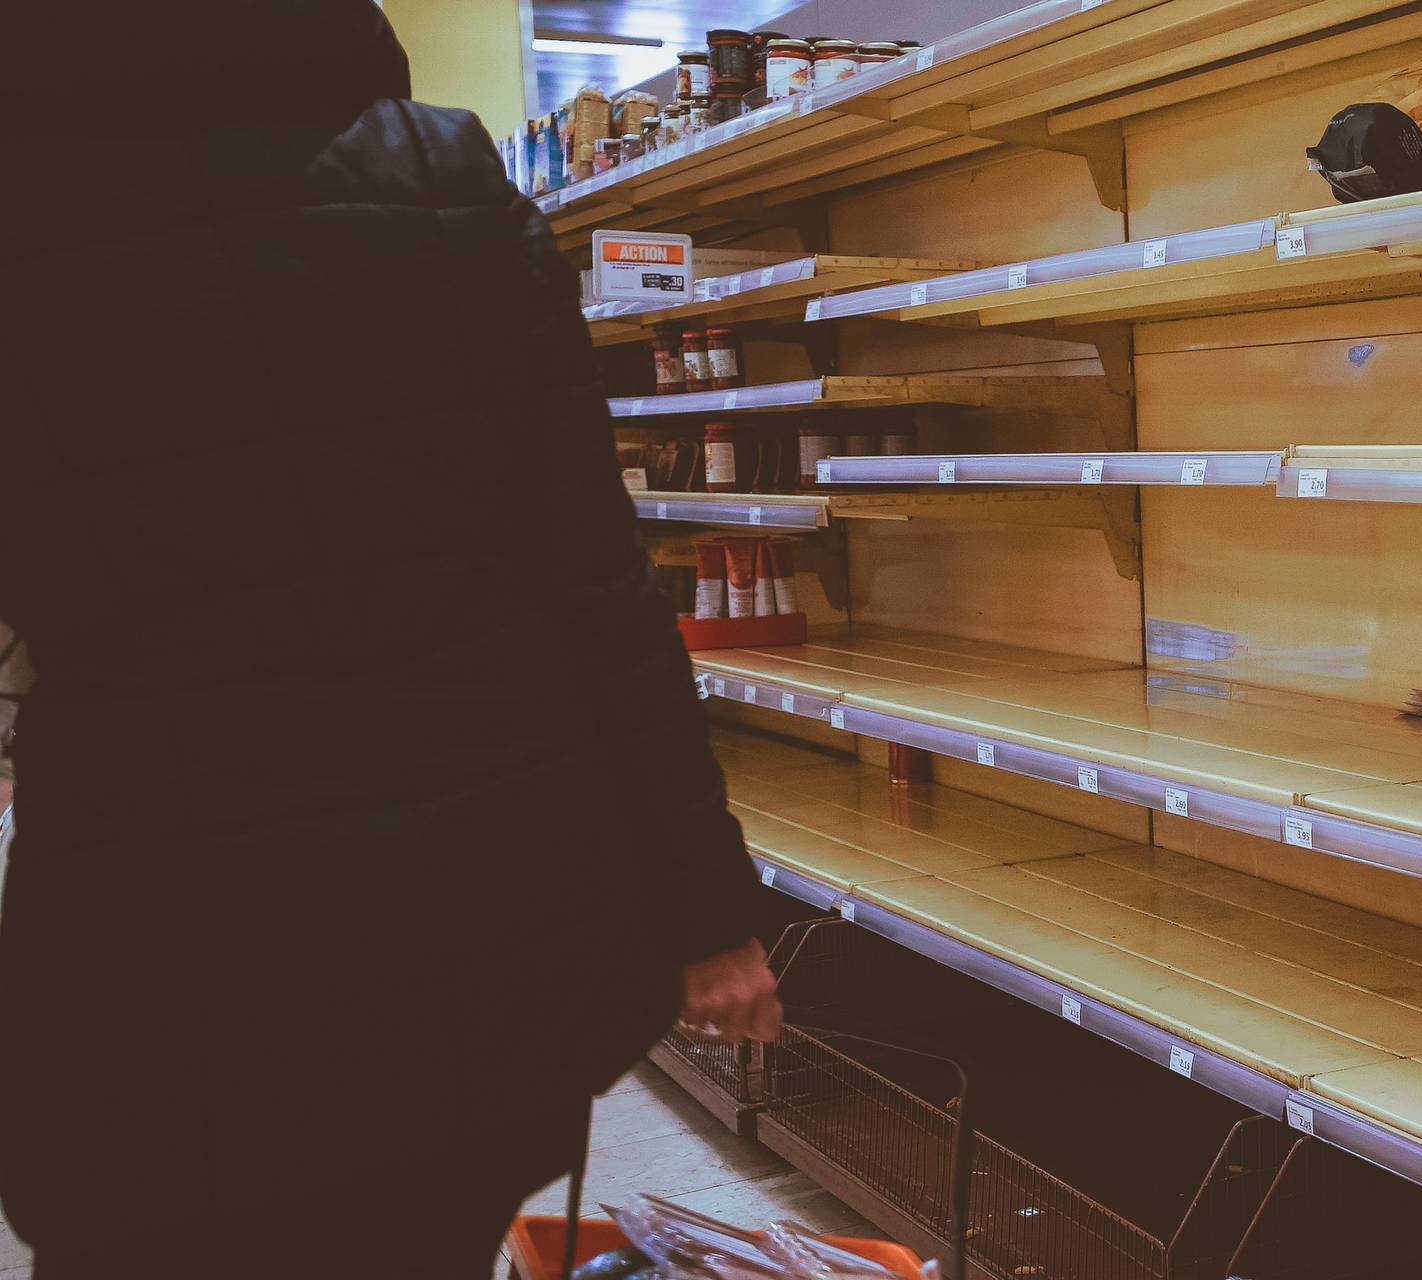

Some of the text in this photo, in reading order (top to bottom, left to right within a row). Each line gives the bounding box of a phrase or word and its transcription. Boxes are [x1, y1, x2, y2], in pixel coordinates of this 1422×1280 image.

[1290, 239, 1303, 249] 3.90
[620, 245, 668, 262] ACTION
[1311, 480, 1324, 490] 2.70
[1297, 830, 1310, 840] 3.95
